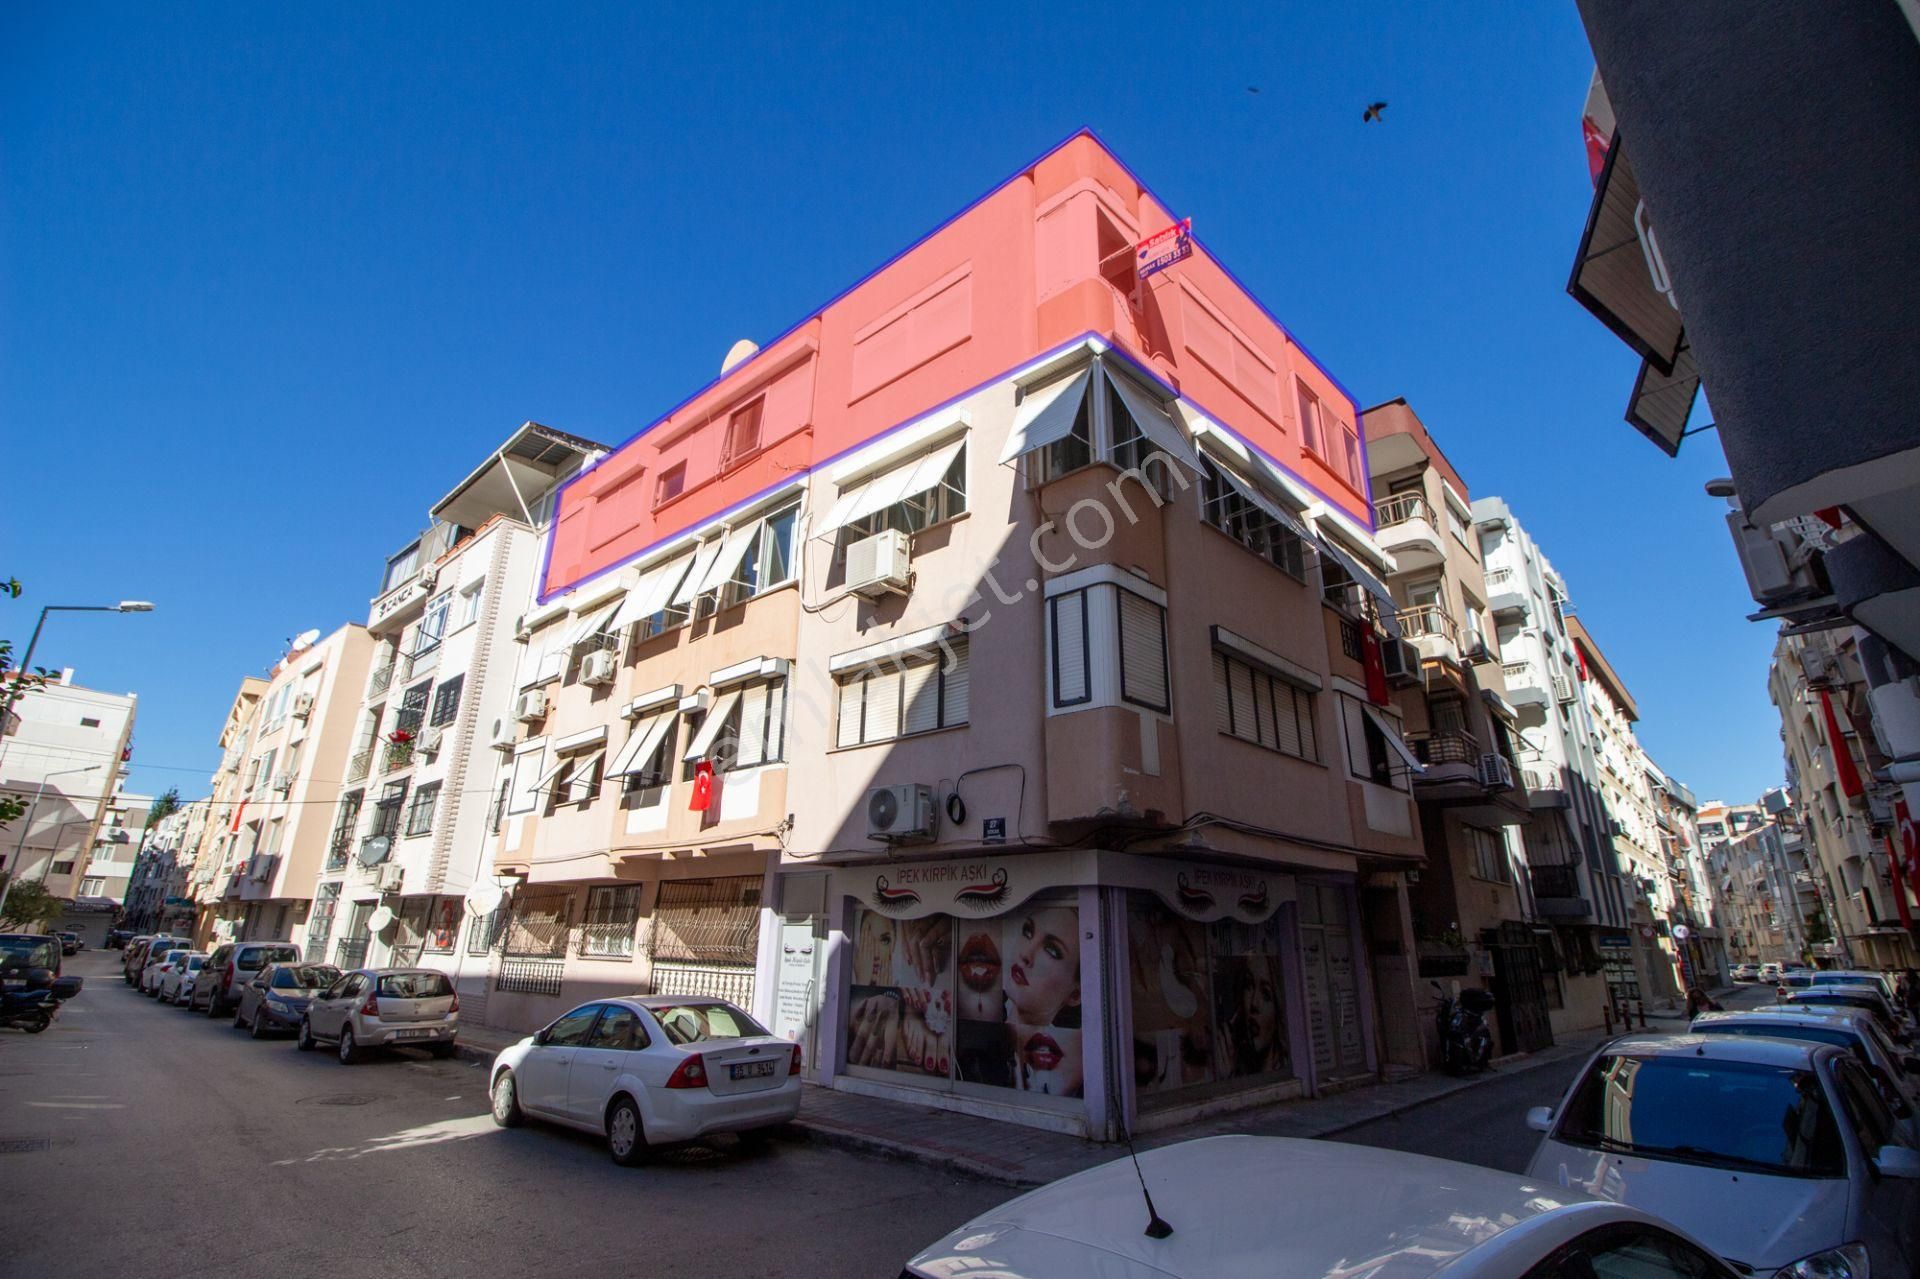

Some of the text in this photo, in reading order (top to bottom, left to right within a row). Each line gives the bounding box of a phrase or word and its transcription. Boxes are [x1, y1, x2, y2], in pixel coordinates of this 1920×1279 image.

[897, 863, 987, 884] İPEK KİRPİK AŞKI
